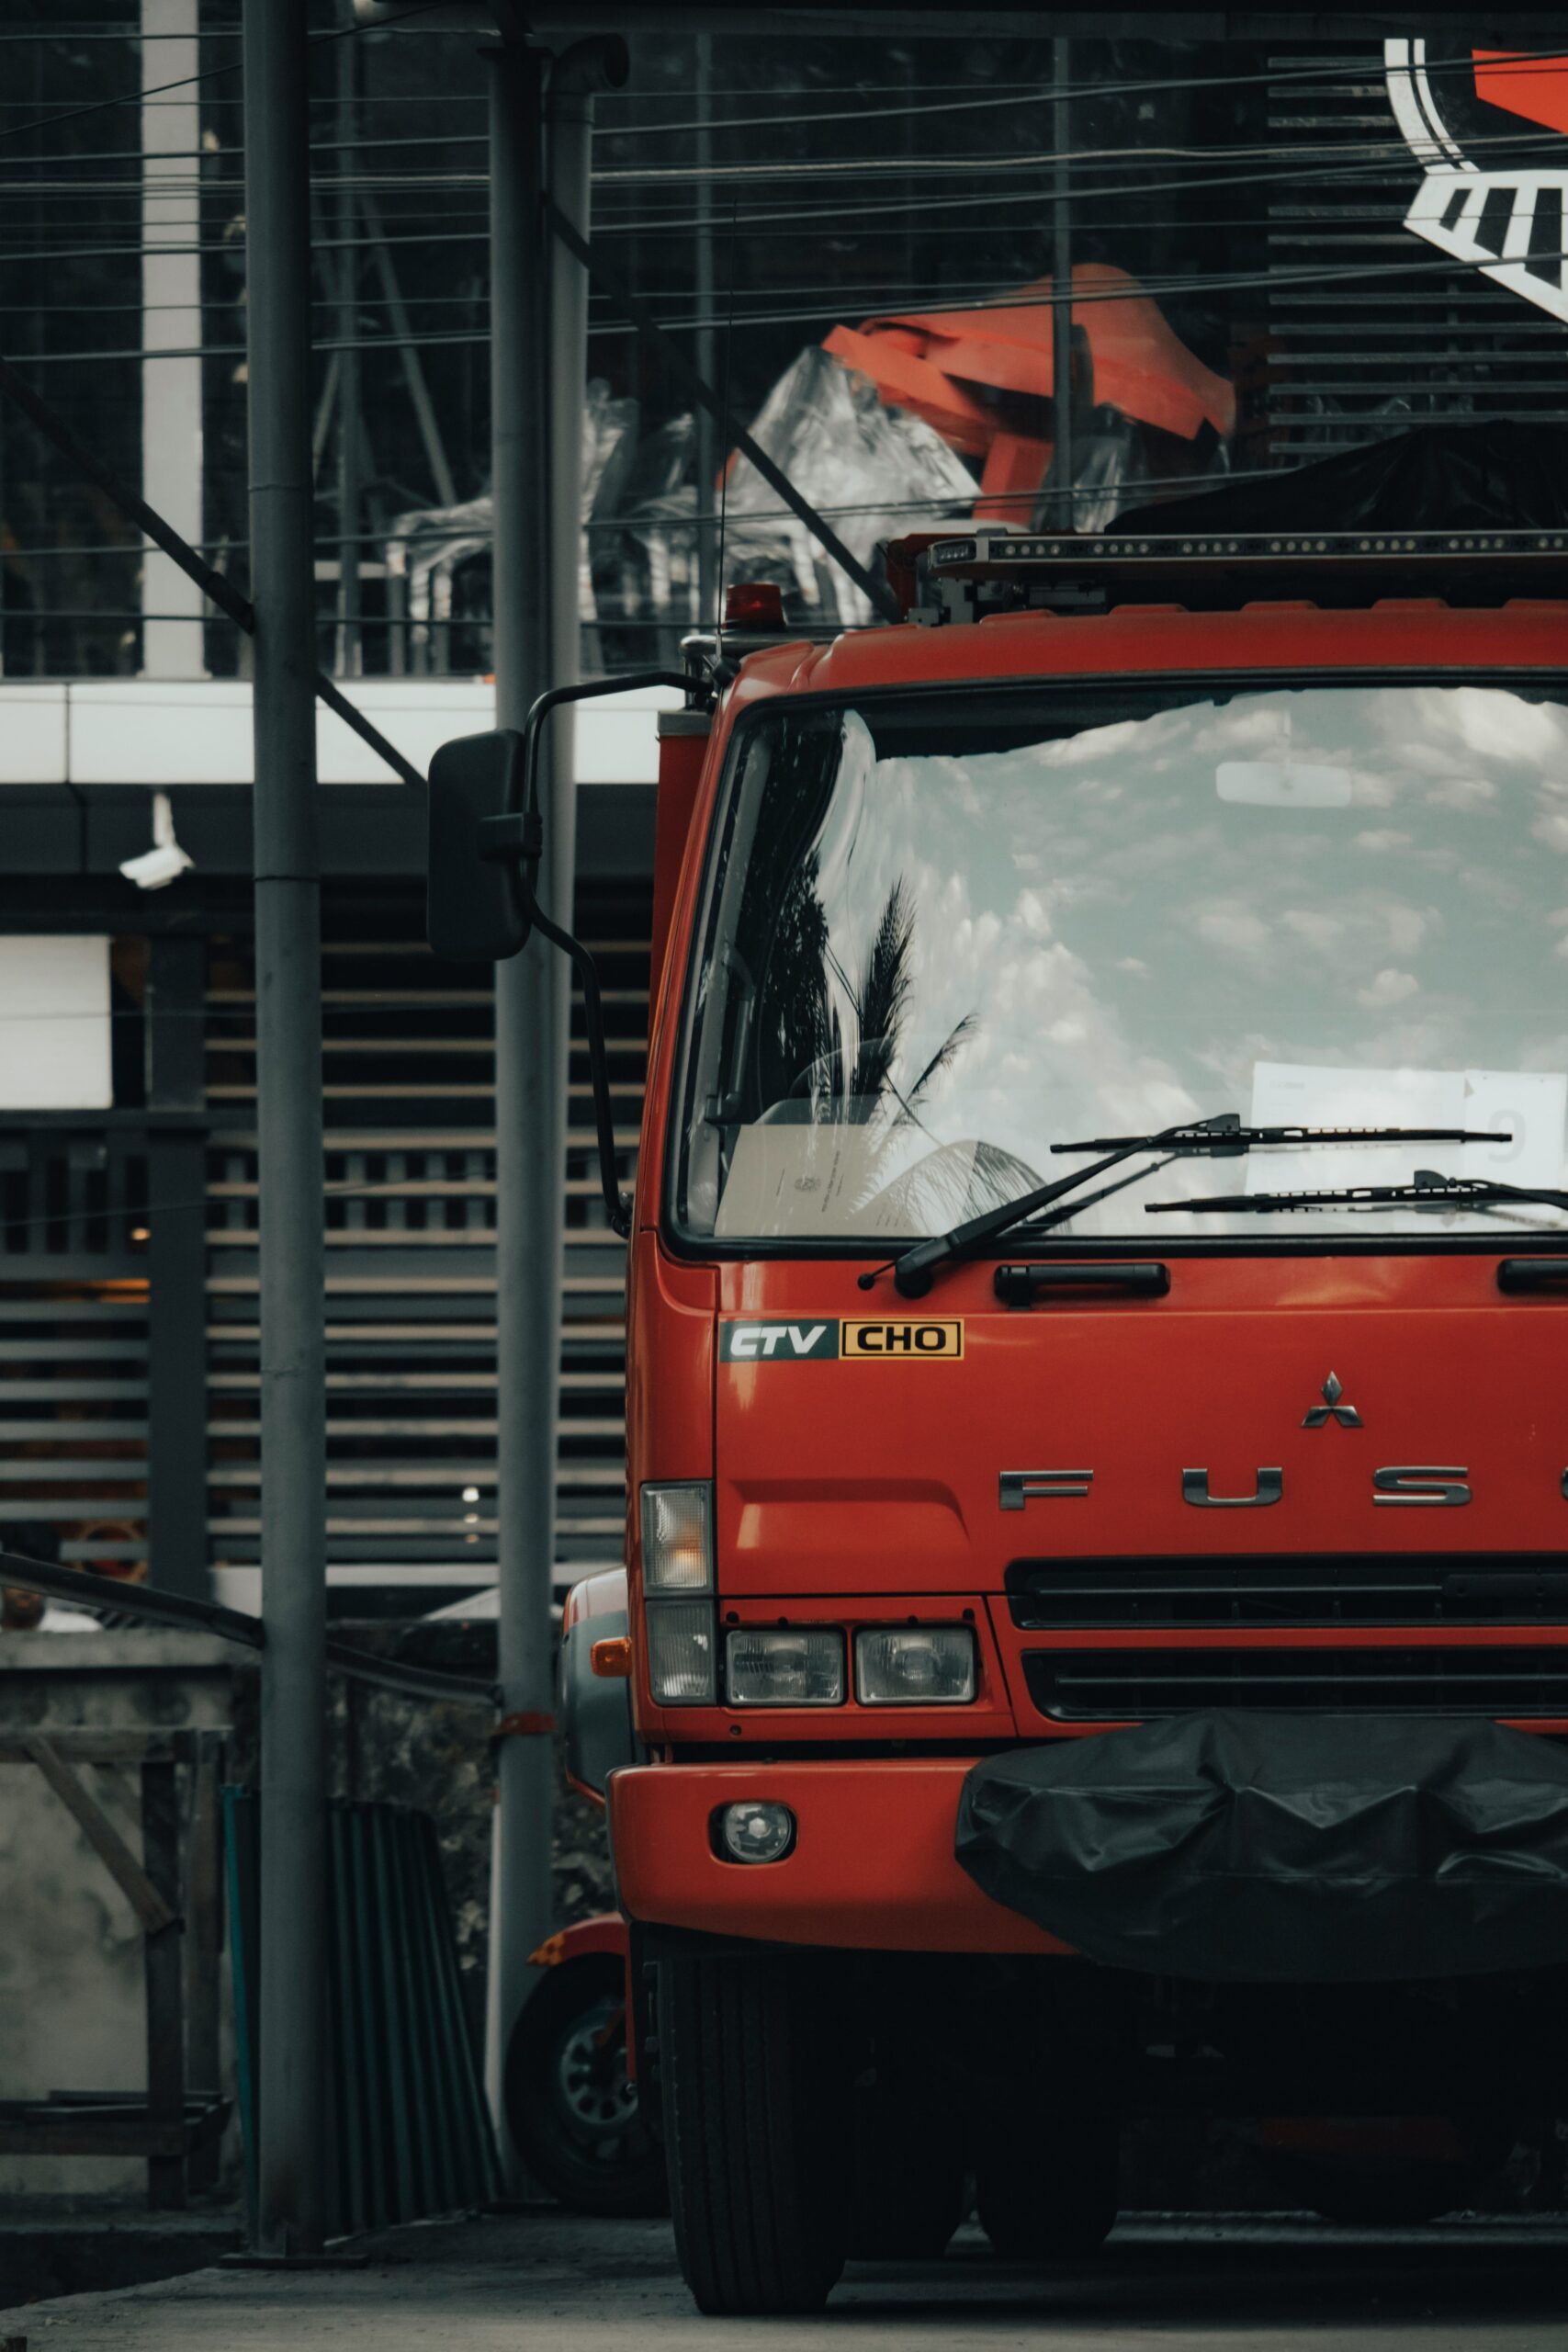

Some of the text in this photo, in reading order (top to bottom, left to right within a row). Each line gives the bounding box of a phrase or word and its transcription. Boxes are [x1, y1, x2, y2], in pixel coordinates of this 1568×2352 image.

[1487, 1108, 1527, 1163] 9
[729, 1325, 947, 1357] CTV CHO
[999, 1465, 1568, 1510] FUS
